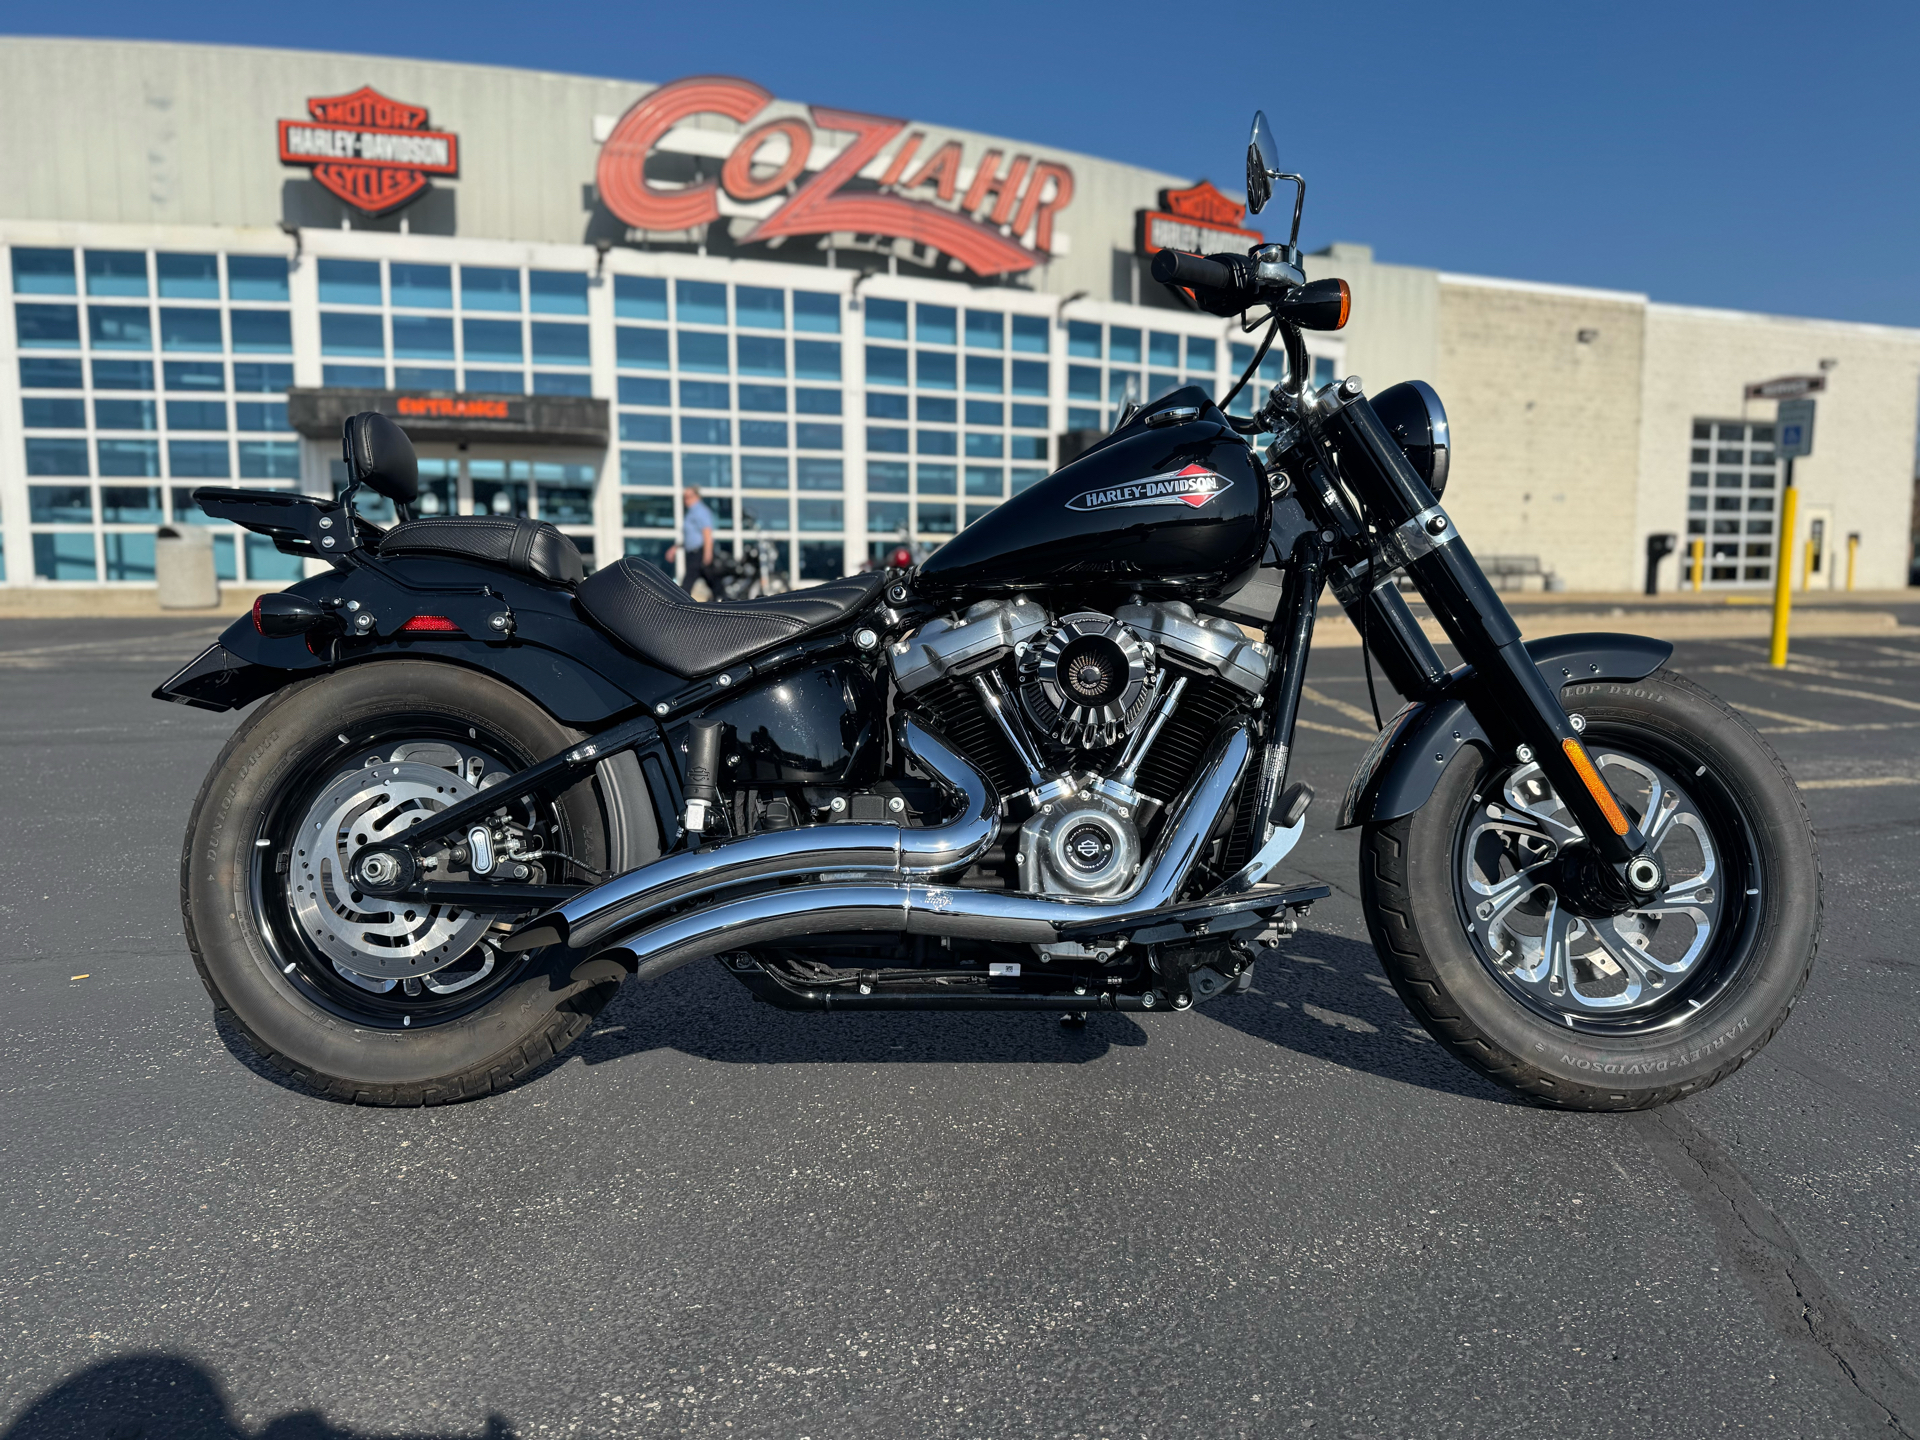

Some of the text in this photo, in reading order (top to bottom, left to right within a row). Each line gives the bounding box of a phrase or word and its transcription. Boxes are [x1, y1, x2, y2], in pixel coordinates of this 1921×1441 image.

[325, 97, 414, 129] MOTOR
[288, 126, 450, 167] HARLEY-DAVIDSON
[327, 164, 412, 201] CYCLES
[1086, 477, 1218, 507] HARLEY-DAVIDSON
[1561, 684, 1601, 698] LOP
[206, 782, 237, 863] DUNLOP
[1560, 1016, 1750, 1075] HARLEY-DAVIDSON
